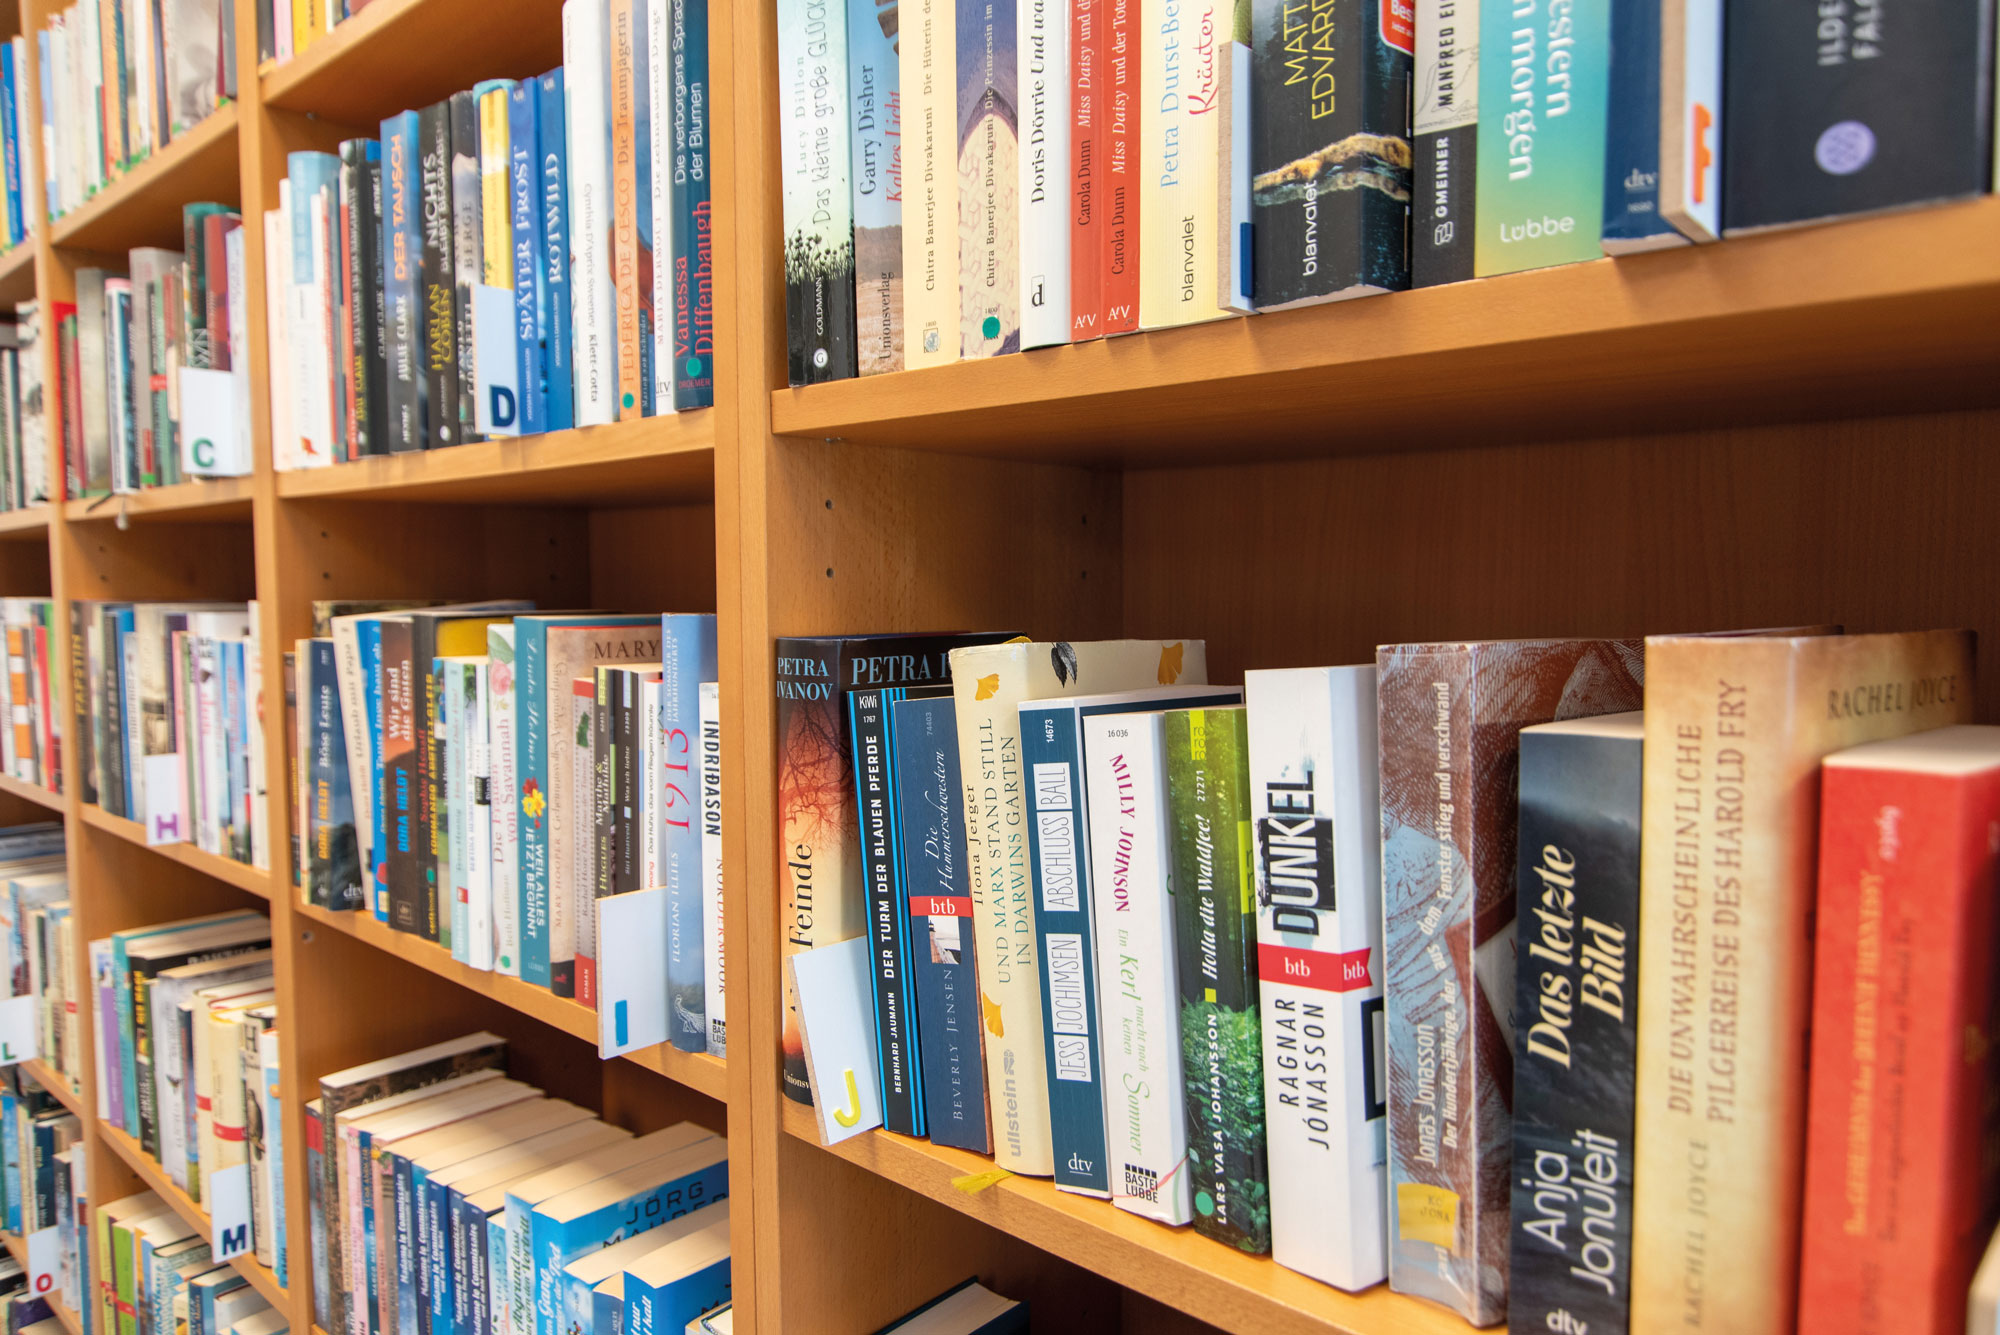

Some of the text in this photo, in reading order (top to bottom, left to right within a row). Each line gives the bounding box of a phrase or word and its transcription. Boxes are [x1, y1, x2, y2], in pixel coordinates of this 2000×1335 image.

[810, 66, 834, 117] große
[1438, 27, 1456, 108] MANFRED
[1502, 27, 1537, 182] morgen
[673, 53, 689, 186] Die verborgene
[689, 81, 704, 183] der Blumen
[857, 65, 881, 195] Garry Disher
[922, 19, 936, 291] Chitra Banerjee Divakaruni Die Hüterin
[984, 24, 996, 287] Chitra Banerjee Divakaruni Die Prinzessin
[1030, 34, 1045, 206] Doris Dörrie Und
[1077, 12, 1095, 226] Carola Dunn Miss Daisy und
[1111, 30, 1129, 275] Carola Dunn Miss Daisy und der
[1160, 125, 1179, 188] Petra
[390, 133, 408, 281] DER TAUSCH
[423, 152, 439, 249] NICHTS
[434, 120, 452, 275] BLEIBT BEGRABEN
[544, 152, 564, 284] ROTWILD
[616, 11, 635, 382] FEDERICA DE CESCO Die Traumjägerin
[1434, 136, 1449, 218] GMEINER
[513, 145, 535, 342] SPÄTER FROST
[1181, 214, 1195, 303] blanvalet
[1302, 179, 1318, 277] blanvalet
[440, 288, 455, 364] COBEN
[675, 256, 690, 358] Vanessa
[692, 199, 714, 356] Diffenbaugh
[815, 276, 825, 336] GOLDMANN
[878, 271, 894, 360] Unionsverlag
[395, 295, 411, 382] JULIE CLARK
[428, 283, 445, 371] HARLAN
[588, 334, 599, 402] Klett-Cotta
[191, 437, 215, 468] C
[488, 384, 517, 429] D
[400, 659, 412, 711] Guten
[593, 640, 660, 660] MARY
[777, 657, 829, 677] PETRA
[777, 680, 833, 701] IVANOV
[850, 652, 932, 686] PETRA
[386, 667, 401, 740] Wir sind
[1827, 682, 1904, 720] RACHEL
[496, 717, 515, 806] Savannah
[595, 776, 604, 826] Marthe
[664, 728, 690, 834] 1913
[1431, 681, 1453, 900] Fenster verschwand
[156, 813, 178, 840] H
[397, 814, 410, 852] DORA
[966, 784, 984, 906] Ilona Jerger
[979, 718, 1012, 985] UND MARX STAND STILL
[1000, 735, 1031, 967] IN DARWINS GARTEN
[1040, 767, 1074, 907] ABSCHLUSS BALL
[1109, 753, 1136, 913] MILLY JOHNSON
[1267, 770, 1320, 936] DUNKEL
[525, 826, 538, 940] JETZT BEGINNT
[533, 843, 547, 928] WEIL ALLES
[670, 852, 681, 964] FLORIAN ILLIES
[789, 844, 813, 949] Feinde
[865, 735, 903, 1093] BERNHARD JAUMANN DER TURM DER BLAUEN PFERDE
[931, 898, 956, 915] btb
[1196, 813, 1218, 980] Holla die Waldfee!
[1667, 723, 1702, 1117] DIE UNWAHRSCHEINLICHE
[1706, 679, 1748, 1125] PILGERREISE DES HAROLD FRY
[1119, 953, 1142, 1002] Kerl
[1284, 957, 1311, 978] btb
[1342, 961, 1366, 982] btb
[1526, 843, 1576, 1071] Das letzte
[1579, 915, 1627, 1025] Bild
[943, 969, 963, 1122] BEVERLY JENSEN
[1051, 939, 1086, 1079] JESS JOCHIMSEN
[1275, 998, 1300, 1107] RAGNAR
[833, 1068, 862, 1128] J
[1302, 1003, 1330, 1150] JÓNASSON
[1413, 1023, 1437, 1111] Jonasson
[1003, 1078, 1022, 1157] ullstein
[1067, 1153, 1093, 1173] dtv
[1205, 1013, 1228, 1226] LARS VASA JOHANSSON
[1413, 1110, 1438, 1168] Jonas
[626, 1181, 704, 1225] JÖRG
[1124, 1171, 1159, 1192] BASTEI
[1522, 1149, 1579, 1251] Anja
[1569, 1128, 1619, 1297] Jonuleit
[35, 1272, 53, 1294] O
[222, 1224, 247, 1256] M
[537, 1267, 555, 1319] Gang
